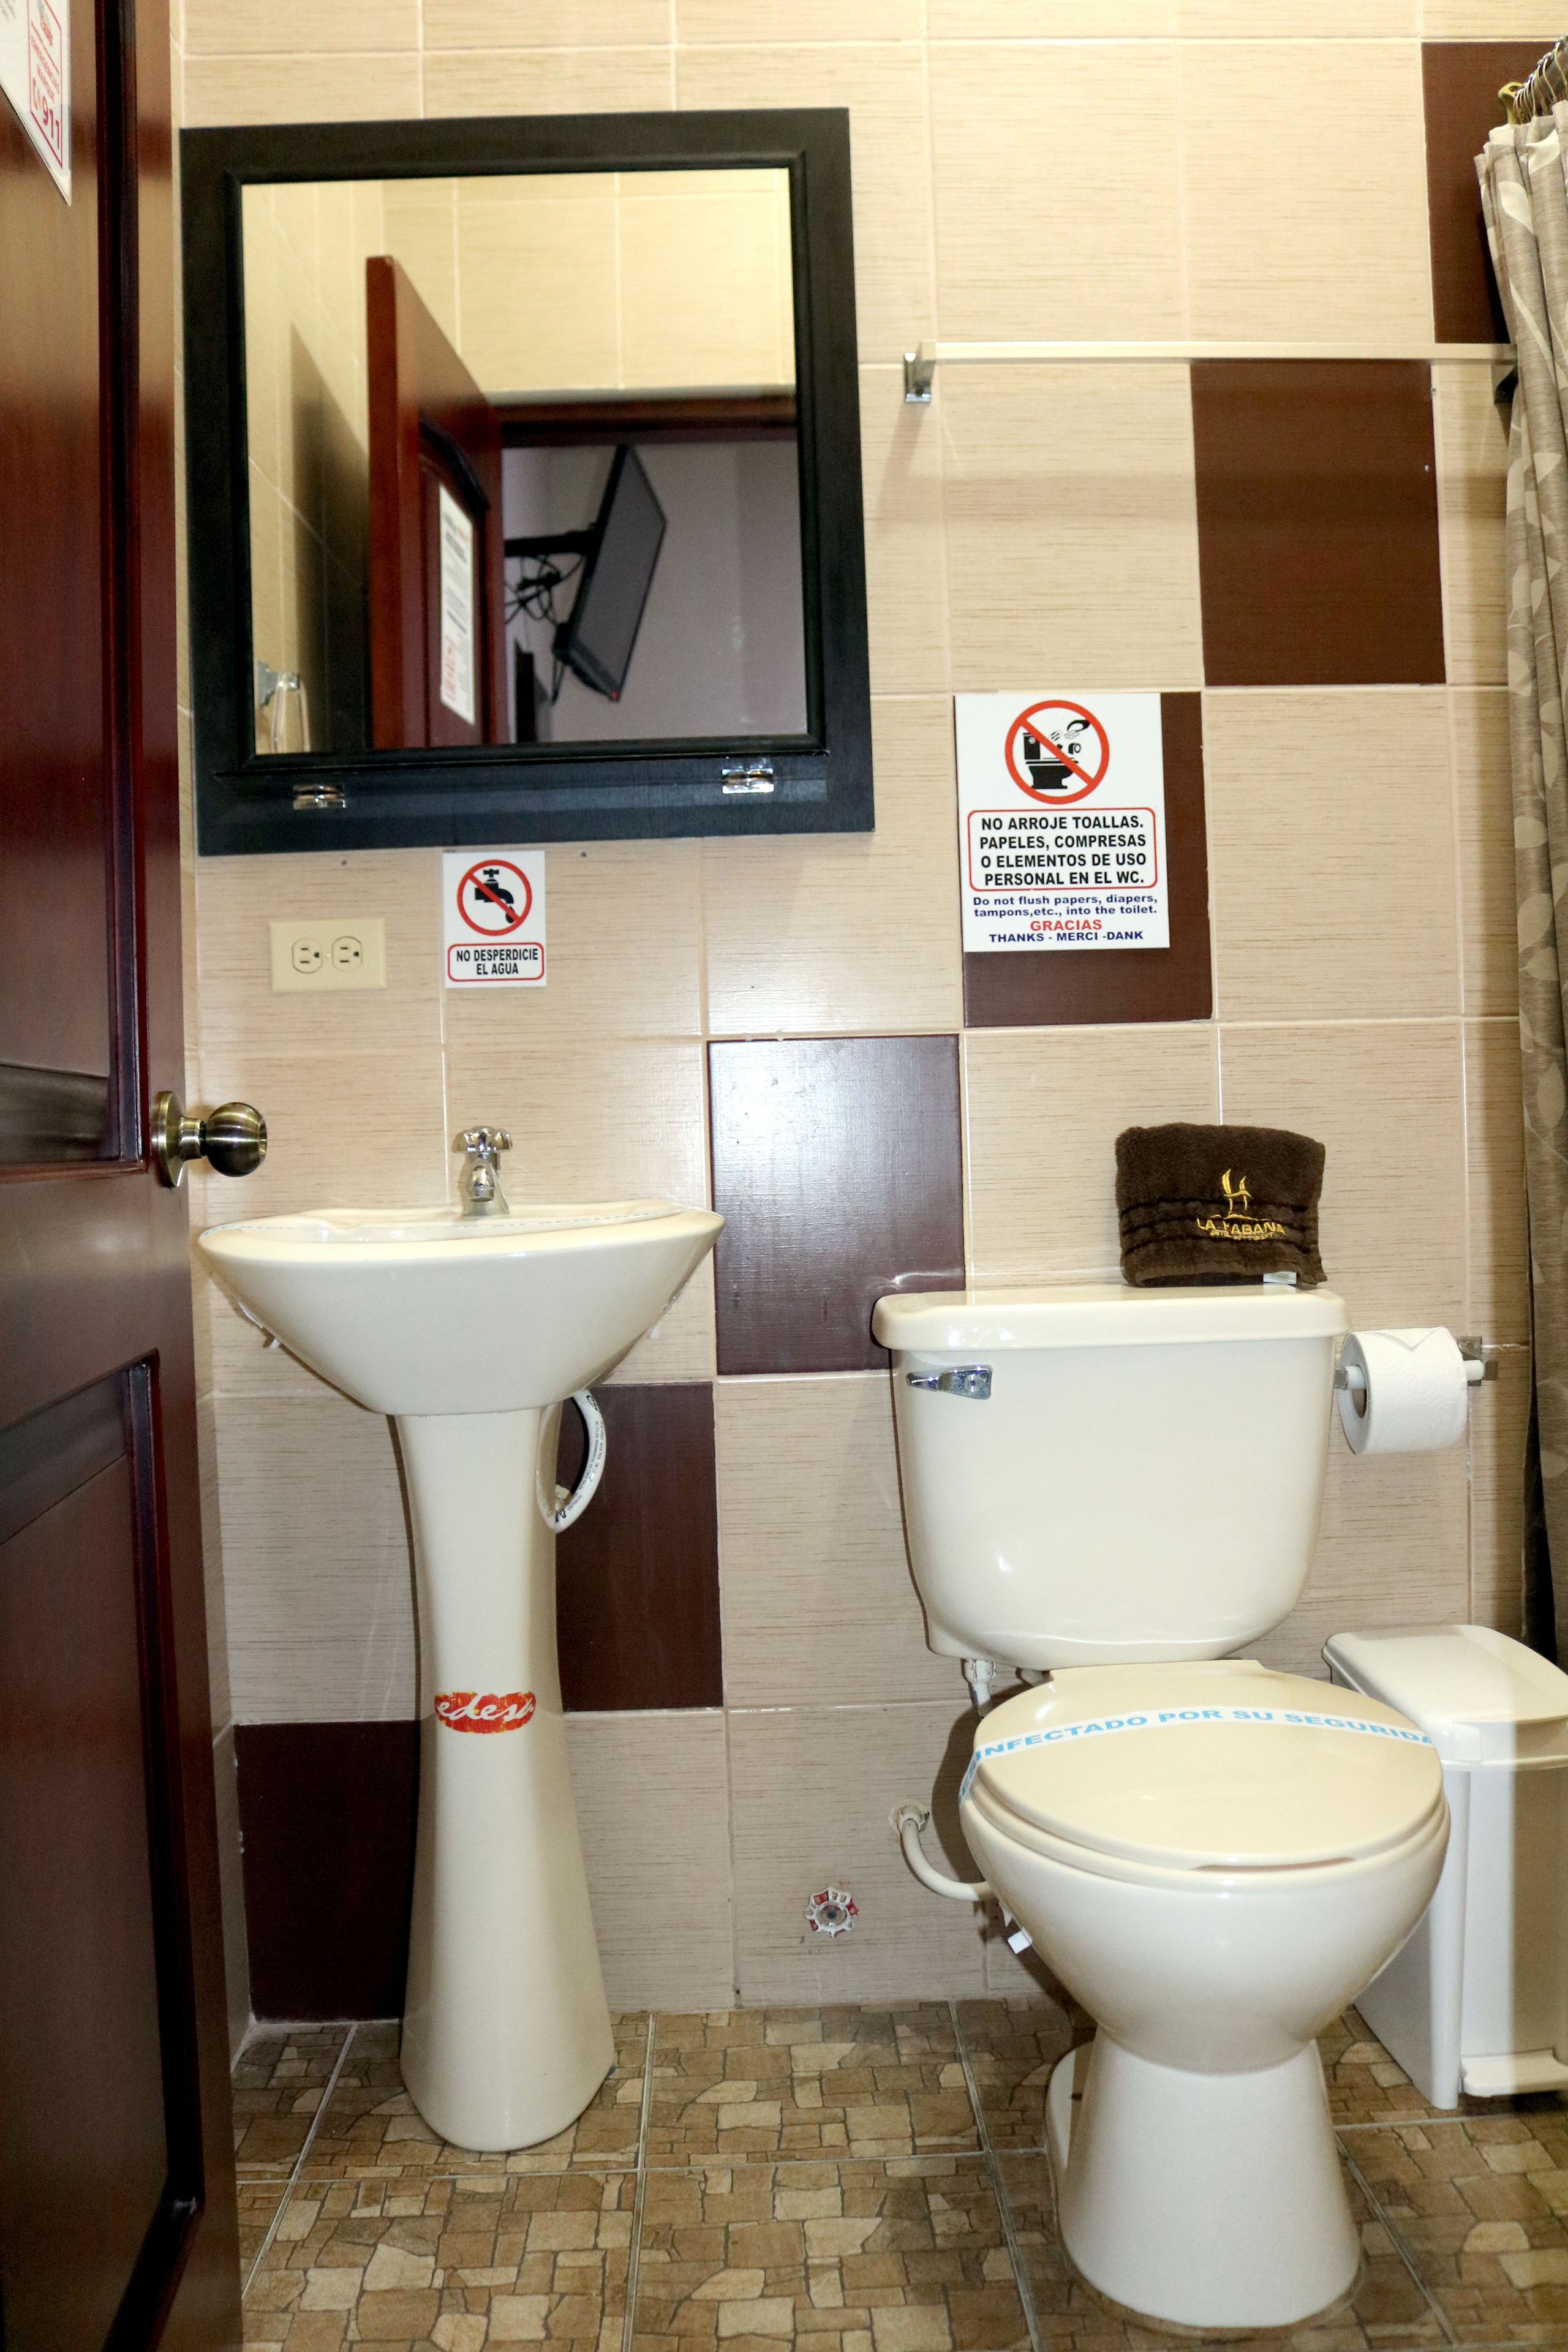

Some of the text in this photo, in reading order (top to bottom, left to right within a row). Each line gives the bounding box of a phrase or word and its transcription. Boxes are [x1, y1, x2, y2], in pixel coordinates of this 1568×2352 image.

[982, 816, 1144, 830] NO ARROJE TOALLAS.
[980, 834, 1146, 850] PAPELES, COMPRESAS
[981, 853, 1146, 867] O ELEMENTOS DE USO
[985, 871, 1144, 886] PERSONAL EN EL WC.
[973, 897, 989, 905] Do
[1019, 895, 1050, 905] flush
[1054, 895, 1102, 906] papers,
[1106, 894, 1158, 905] diapers,
[1066, 907, 1090, 915] into
[1095, 906, 1116, 914] the
[1120, 905, 1157, 914] toilet.
[1030, 919, 1102, 931] GRACIAS
[989, 933, 1044, 942] THANKS
[1057, 932, 1098, 941] MERCI
[457, 949, 538, 961] NO DESPERDICIE
[477, 962, 518, 975] EL AGUA
[1196, 1218, 1216, 1231] LA
[1158, 1710, 1223, 1723] POR
[1232, 1711, 1273, 1721] SU
